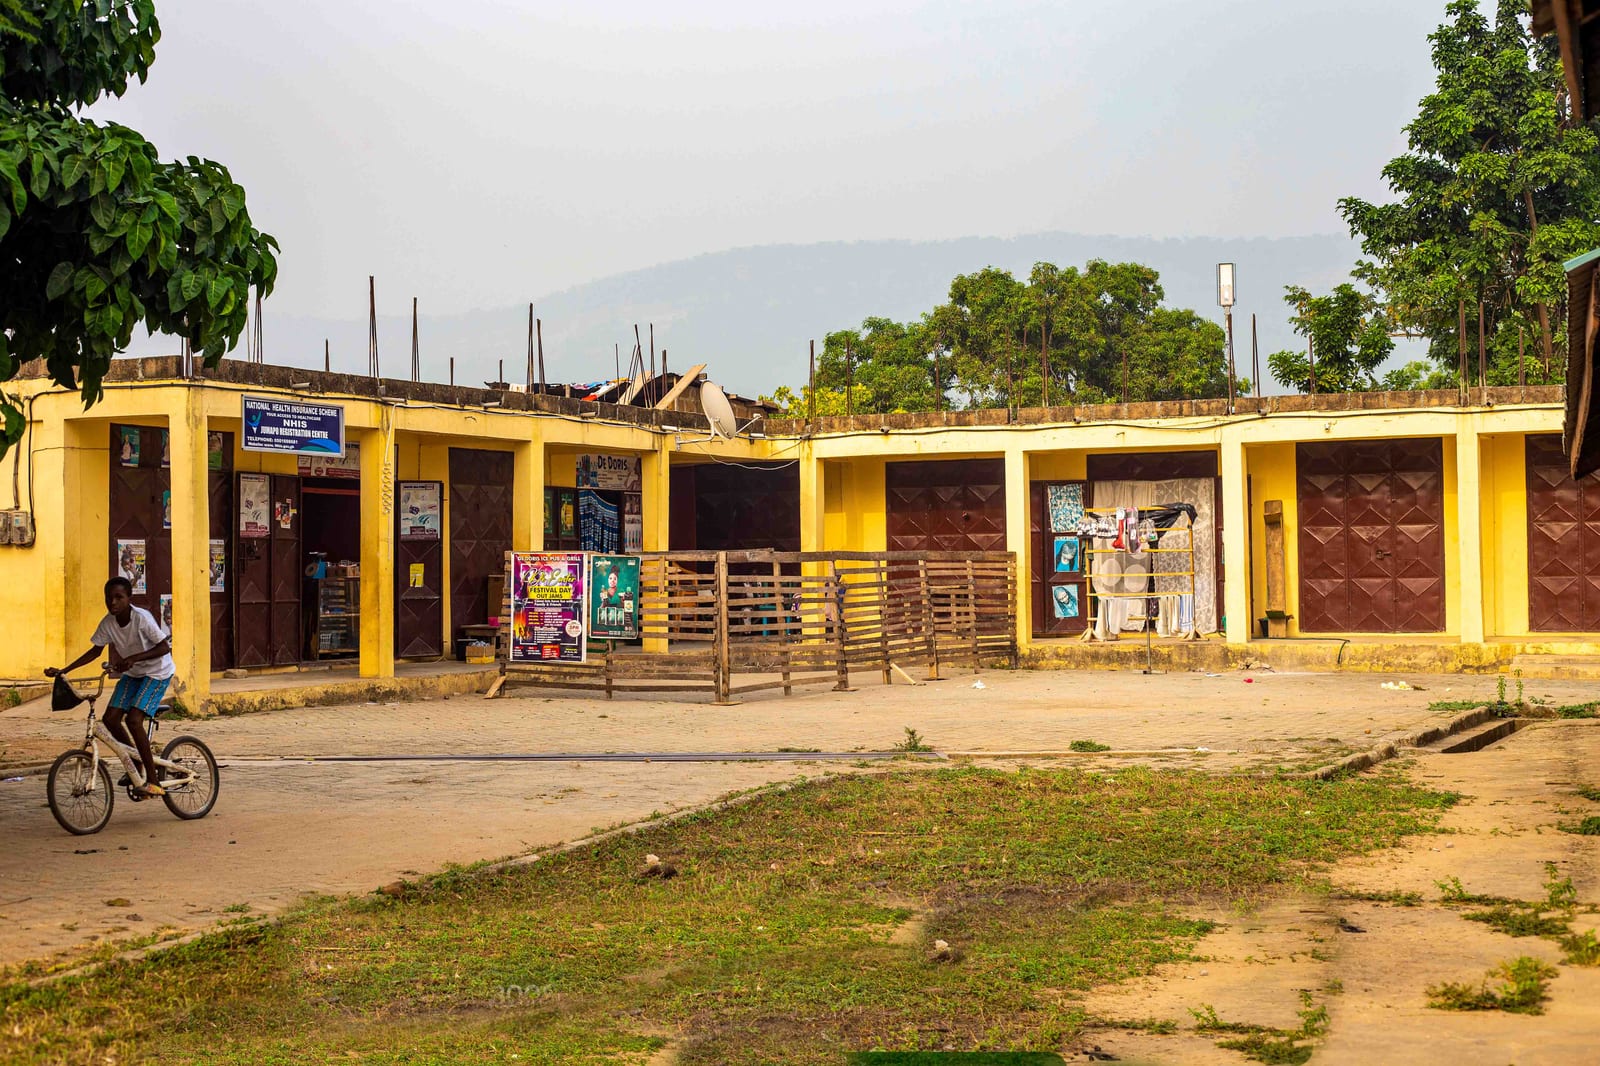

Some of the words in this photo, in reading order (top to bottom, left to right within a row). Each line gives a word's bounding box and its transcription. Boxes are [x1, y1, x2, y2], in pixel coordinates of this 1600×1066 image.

[246, 401, 270, 411] NATIONAL
[272, 403, 291, 413] HEALTH
[291, 405, 318, 416] INSURANCE
[318, 408, 337, 417] SCHEME
[283, 419, 308, 428] NHIS
[279, 427, 311, 437] REGISTRATION
[311, 429, 329, 439] CENTRE
[598, 455, 607, 470] DE
[608, 456, 628, 471] DORIS
